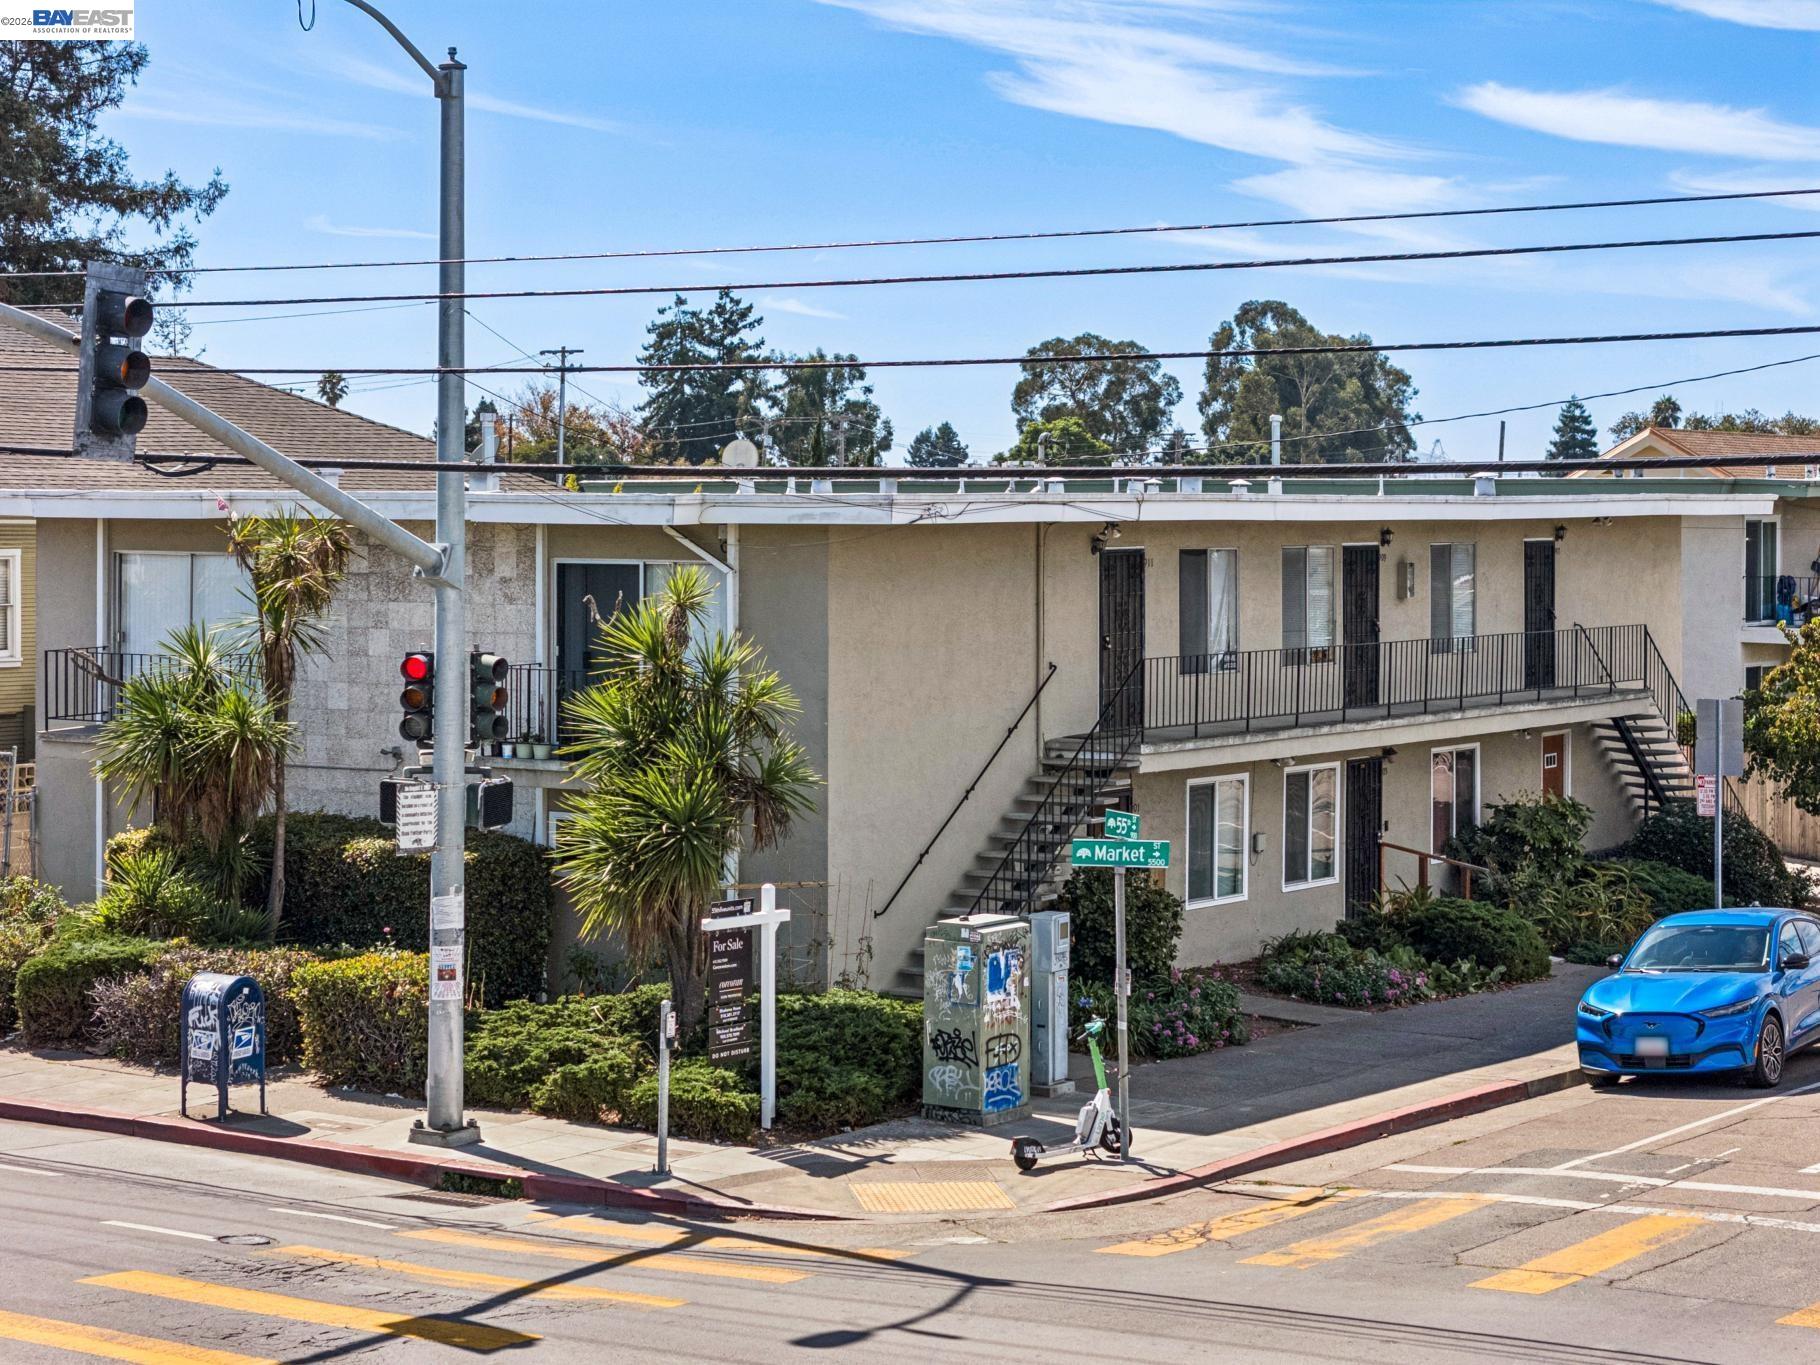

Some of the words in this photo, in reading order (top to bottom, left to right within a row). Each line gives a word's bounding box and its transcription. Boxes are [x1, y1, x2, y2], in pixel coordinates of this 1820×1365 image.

[1094, 845, 1145, 861] Market
[713, 940, 726, 953] For
[727, 937, 744, 951] Sale
[731, 1047, 750, 1056] DISTURB
